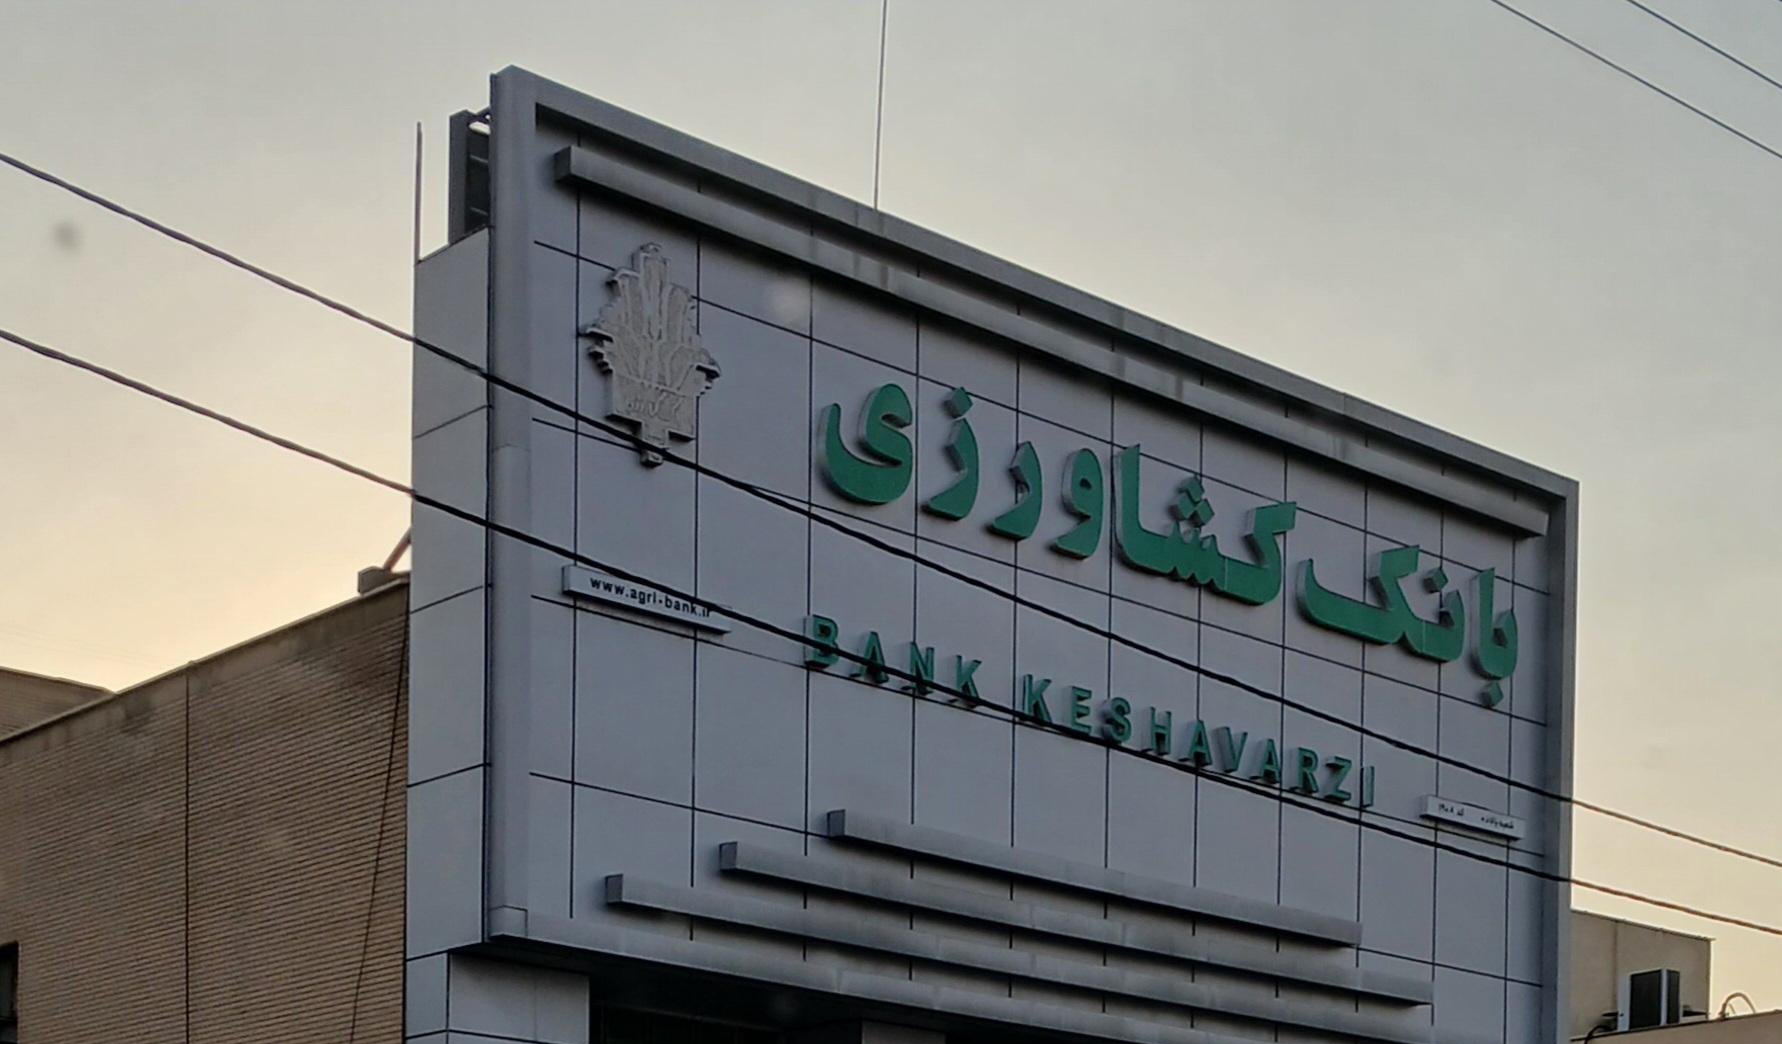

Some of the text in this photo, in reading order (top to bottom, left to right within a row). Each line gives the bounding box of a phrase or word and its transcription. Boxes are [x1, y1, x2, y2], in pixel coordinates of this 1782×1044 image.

[589, 576, 712, 618] www.agri-bank.ir
[819, 382, 1520, 710] بانک کشاورزی
[804, 614, 1375, 809] BANK KESHAVARZI
